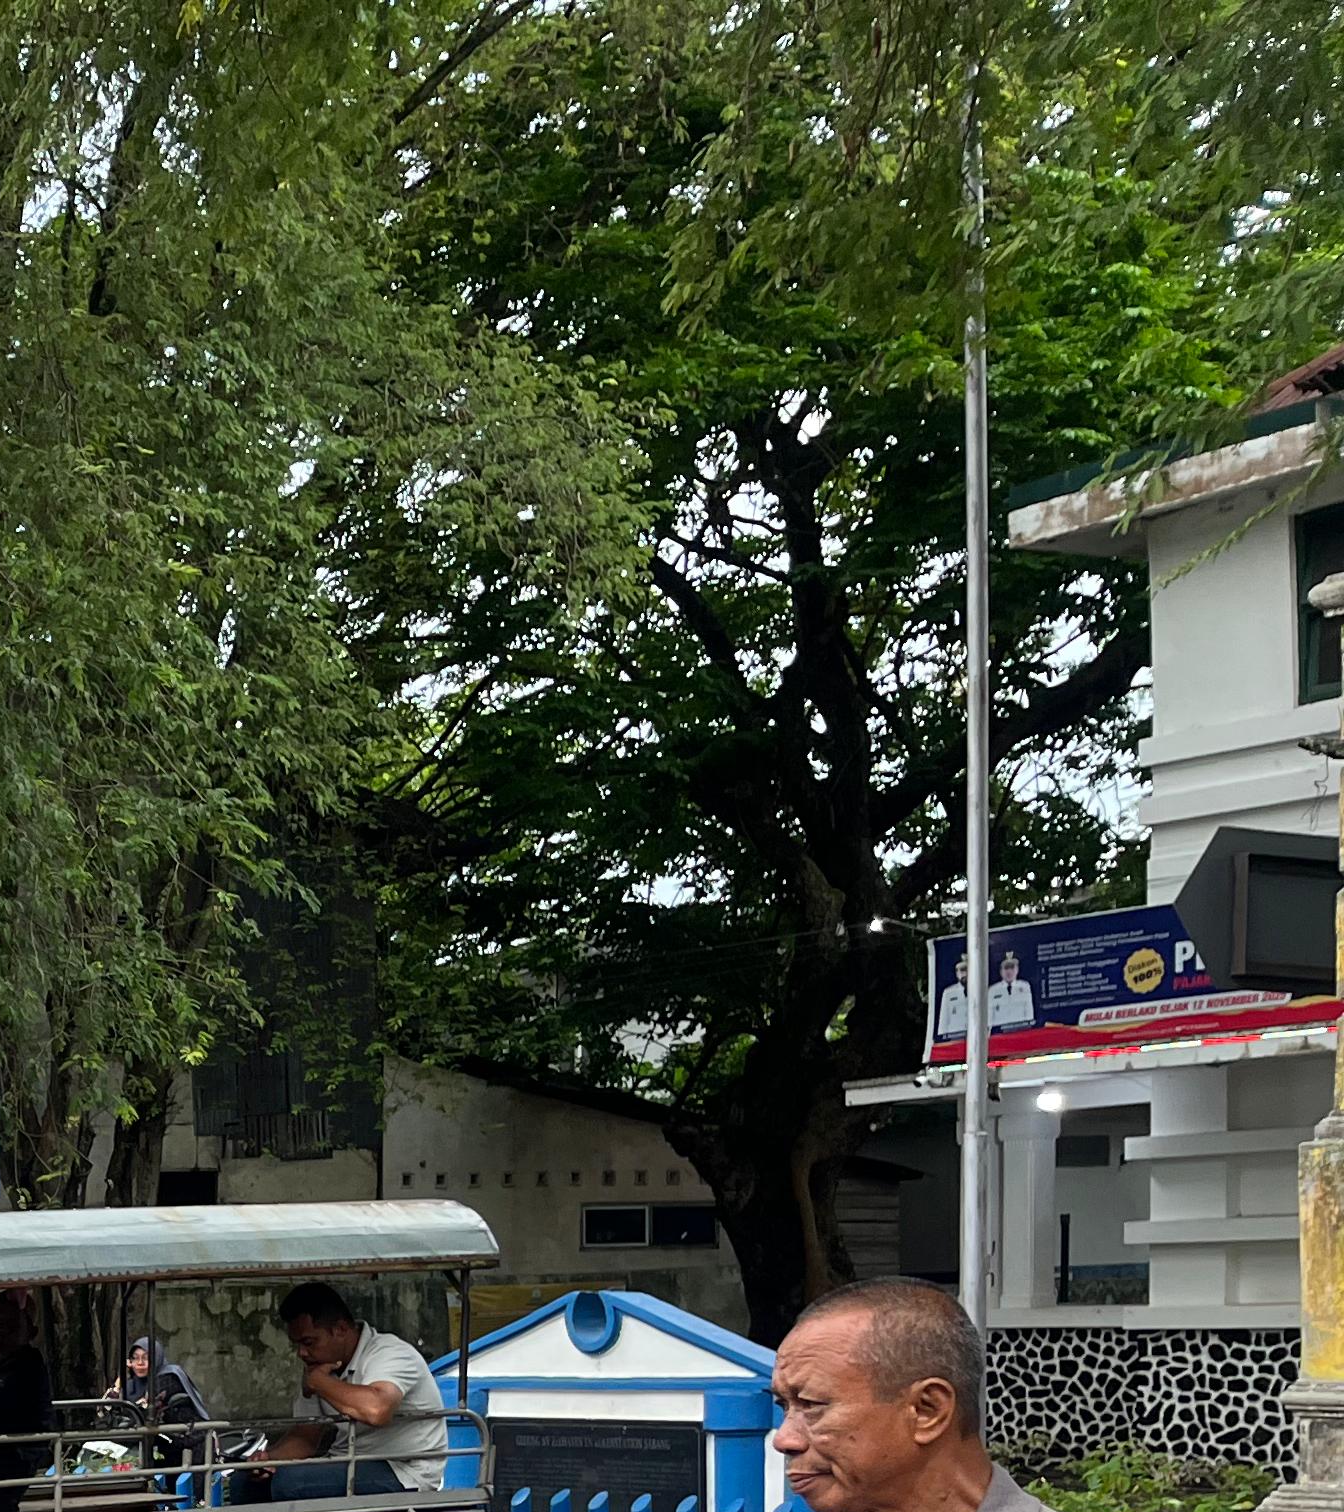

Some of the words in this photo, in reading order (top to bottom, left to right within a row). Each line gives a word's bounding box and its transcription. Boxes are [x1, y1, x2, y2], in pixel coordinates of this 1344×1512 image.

[1132, 968, 1163, 985] 100%
[1084, 1010, 1113, 1023] MULAI
[1115, 1006, 1157, 1019] BERLAKU
[1159, 1002, 1189, 1014] SEJAK
[1206, 993, 1259, 1009] NOVEMBER
